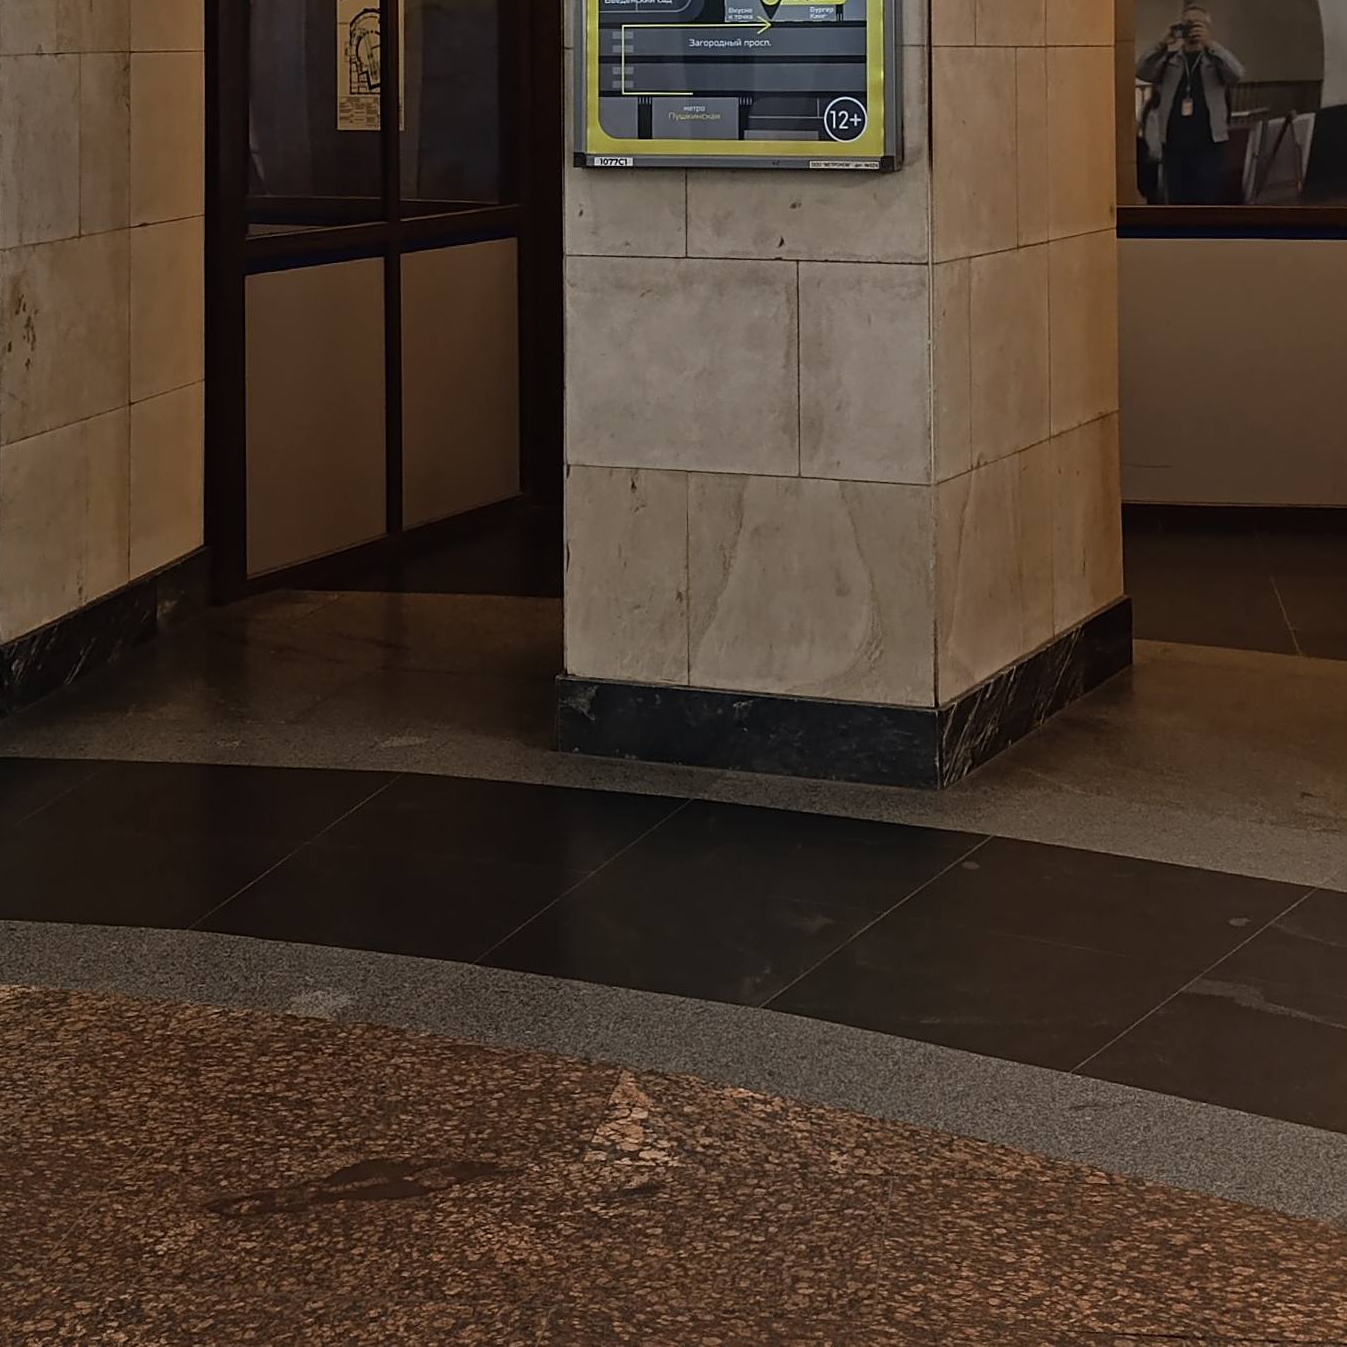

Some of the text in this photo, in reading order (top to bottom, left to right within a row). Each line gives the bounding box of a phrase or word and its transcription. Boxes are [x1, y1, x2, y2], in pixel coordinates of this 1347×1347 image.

[689, 37, 741, 48] Загородный
[668, 111, 721, 121] Пушкинская
[830, 110, 861, 130] 12+
